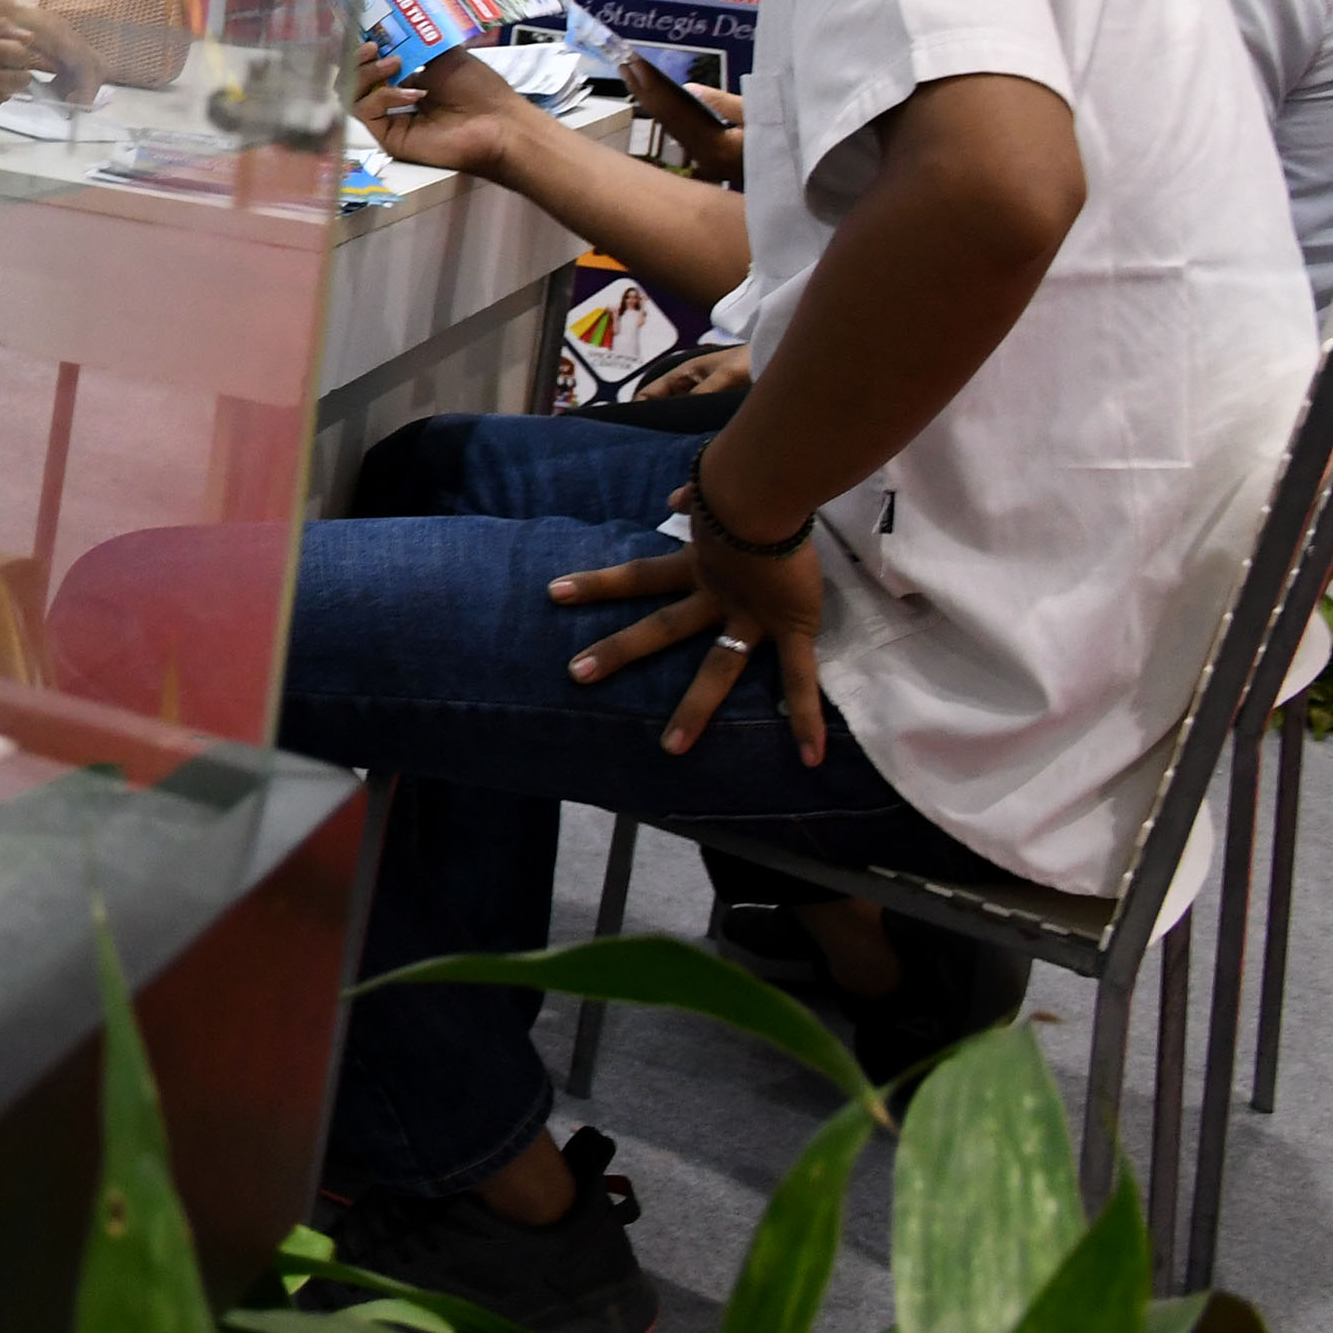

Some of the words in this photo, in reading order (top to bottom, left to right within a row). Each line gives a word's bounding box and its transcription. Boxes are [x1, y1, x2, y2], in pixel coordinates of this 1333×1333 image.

[405, 5, 426, 24] TV
[416, 19, 439, 43] LED
[595, 1, 709, 42] Strategis
